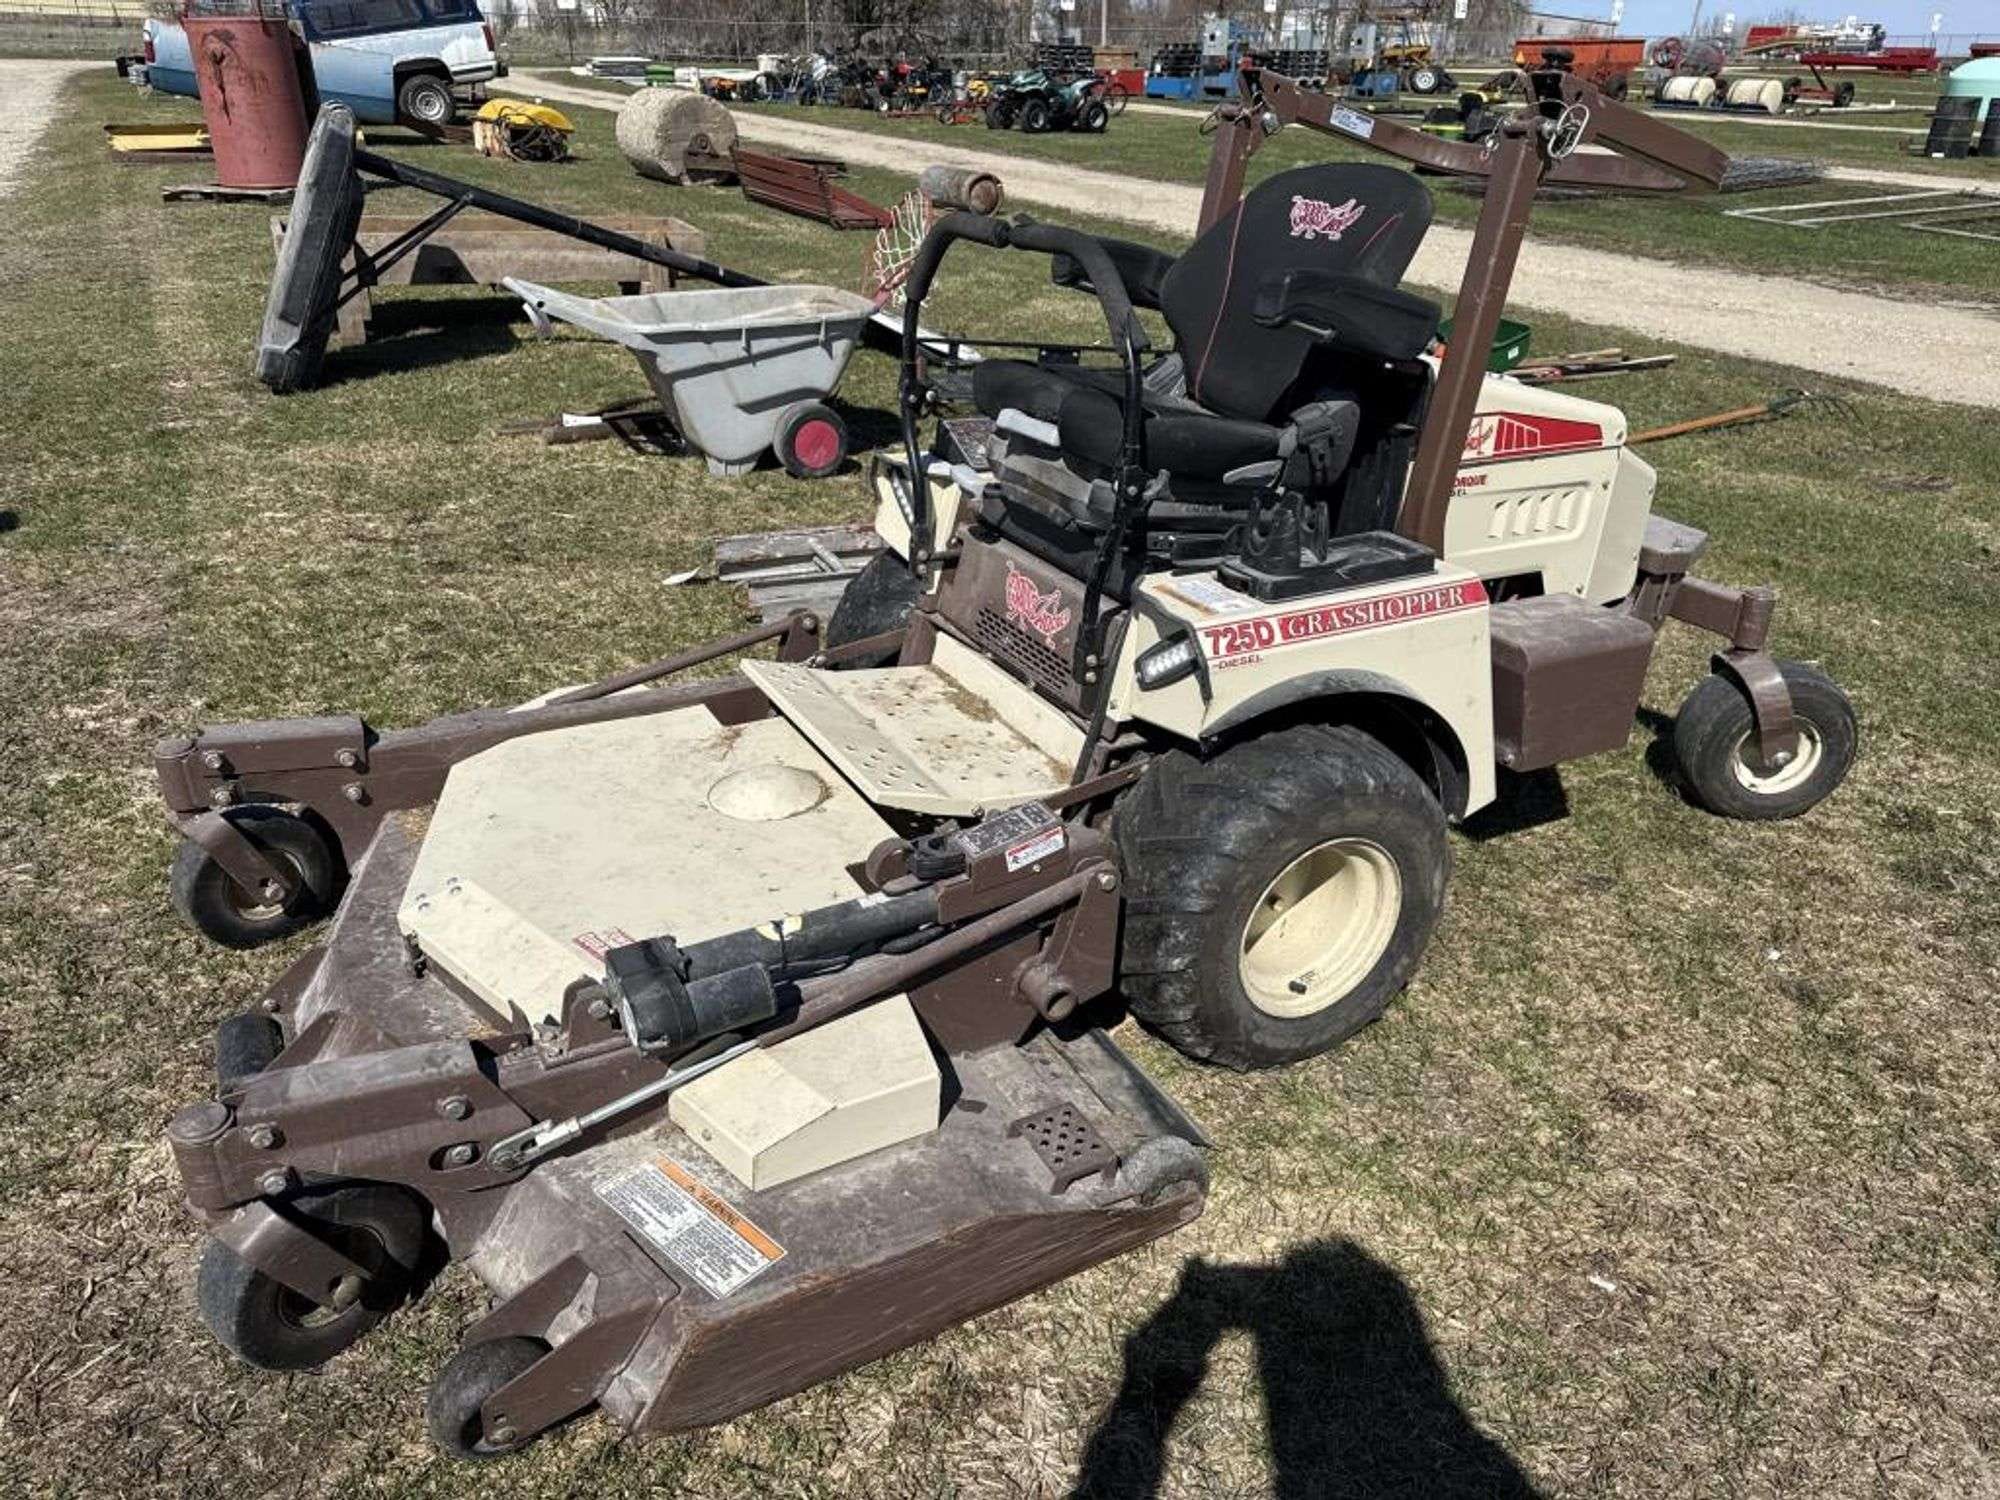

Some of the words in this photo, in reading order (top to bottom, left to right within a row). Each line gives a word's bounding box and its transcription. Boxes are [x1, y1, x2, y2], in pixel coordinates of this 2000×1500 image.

[1453, 474, 1487, 488] ORQUE
[1205, 621, 1275, 656] 725D
[1287, 586, 1464, 639] GRASSHOPPER
[1217, 655, 1264, 670] DIESEL
